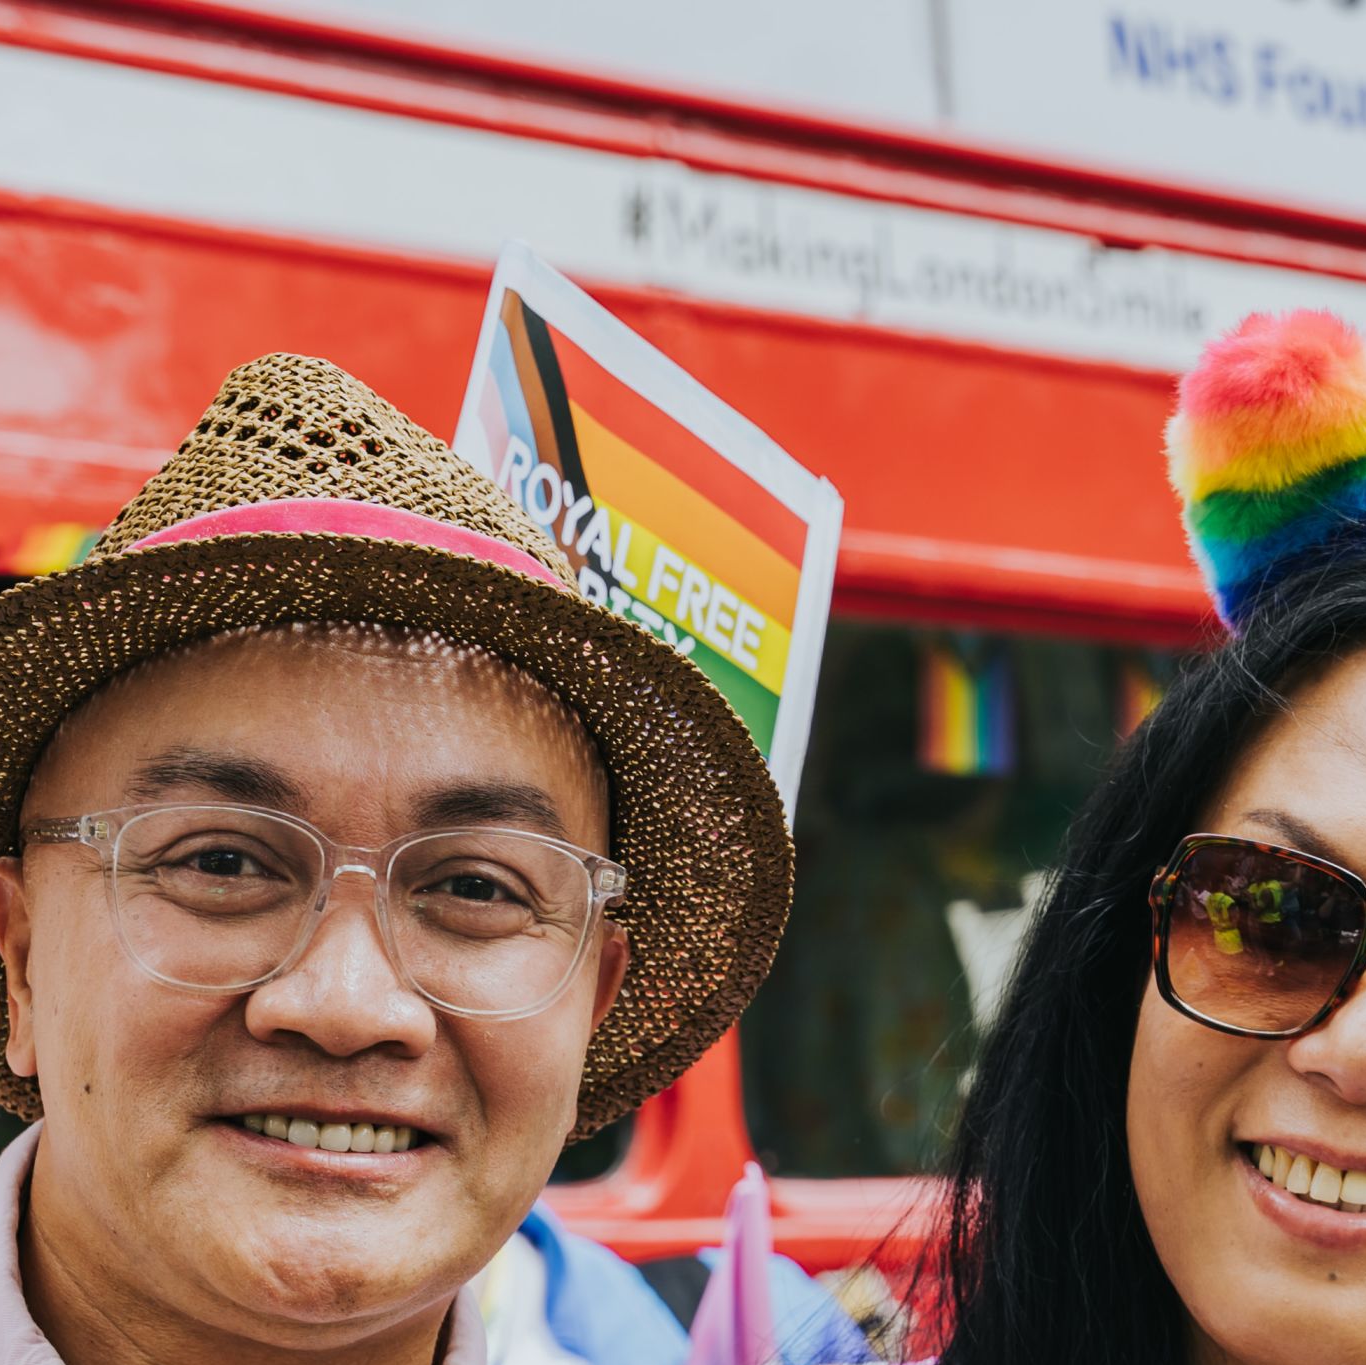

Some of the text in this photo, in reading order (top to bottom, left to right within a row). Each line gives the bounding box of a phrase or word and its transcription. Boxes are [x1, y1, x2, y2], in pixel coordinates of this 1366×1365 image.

[1108, 17, 1240, 104] NHS
[499, 435, 766, 670] ROYAL FREE
